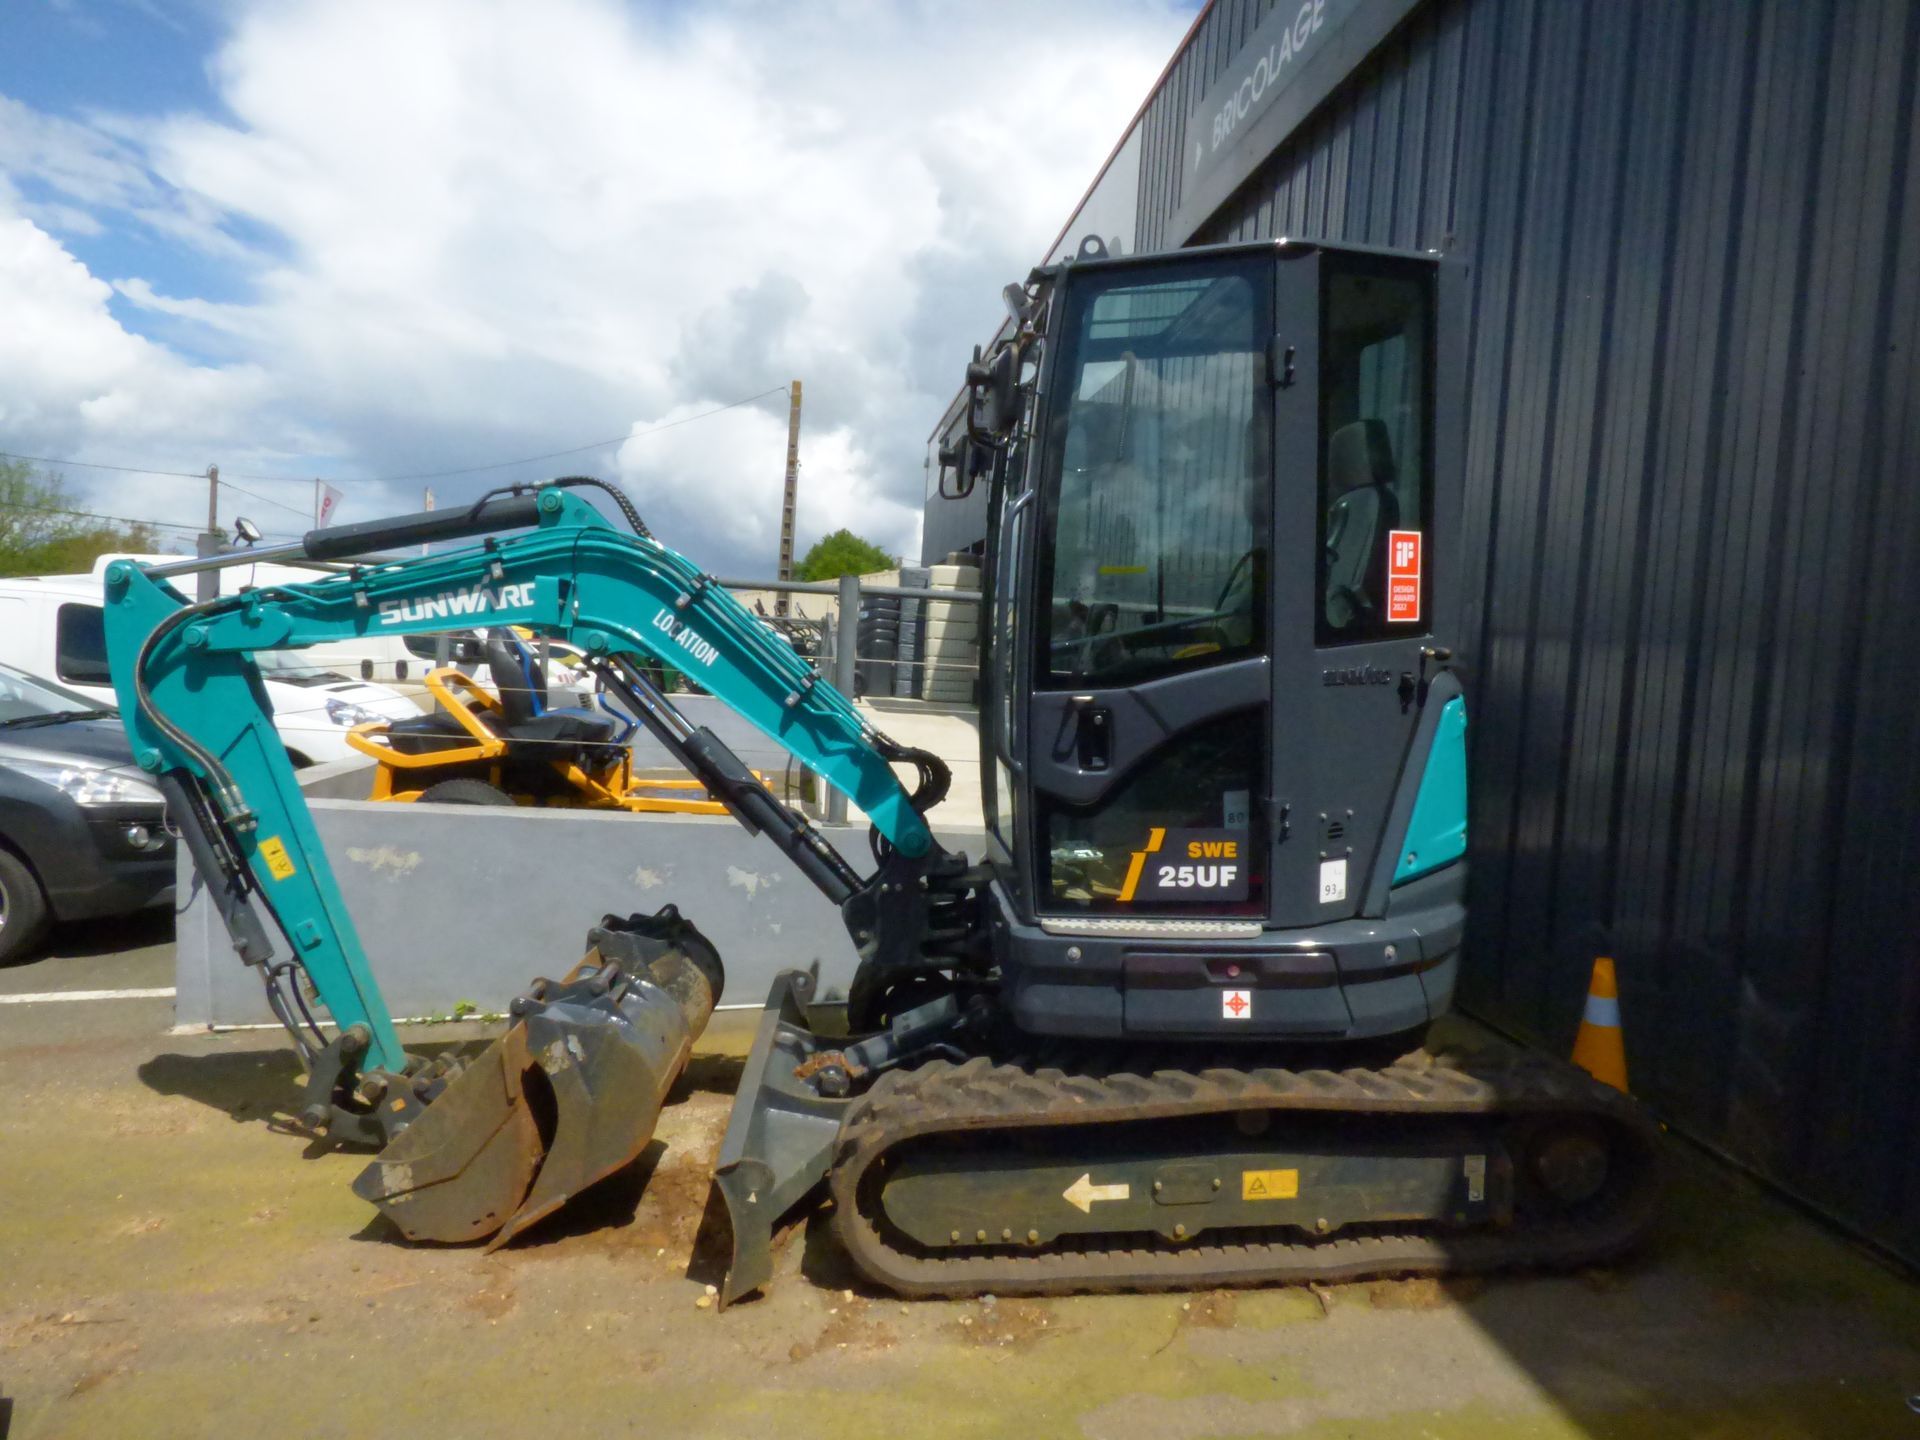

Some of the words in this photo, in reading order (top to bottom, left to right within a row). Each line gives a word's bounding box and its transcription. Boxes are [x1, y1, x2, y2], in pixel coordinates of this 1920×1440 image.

[1212, 0, 1326, 151] BRICOLAGE
[1393, 585, 1415, 593] DESIGN
[1393, 594, 1416, 602] AWARD
[652, 608, 719, 667] LOCATION
[1188, 841, 1237, 858] SWE
[1158, 866, 1237, 887] 25UF
